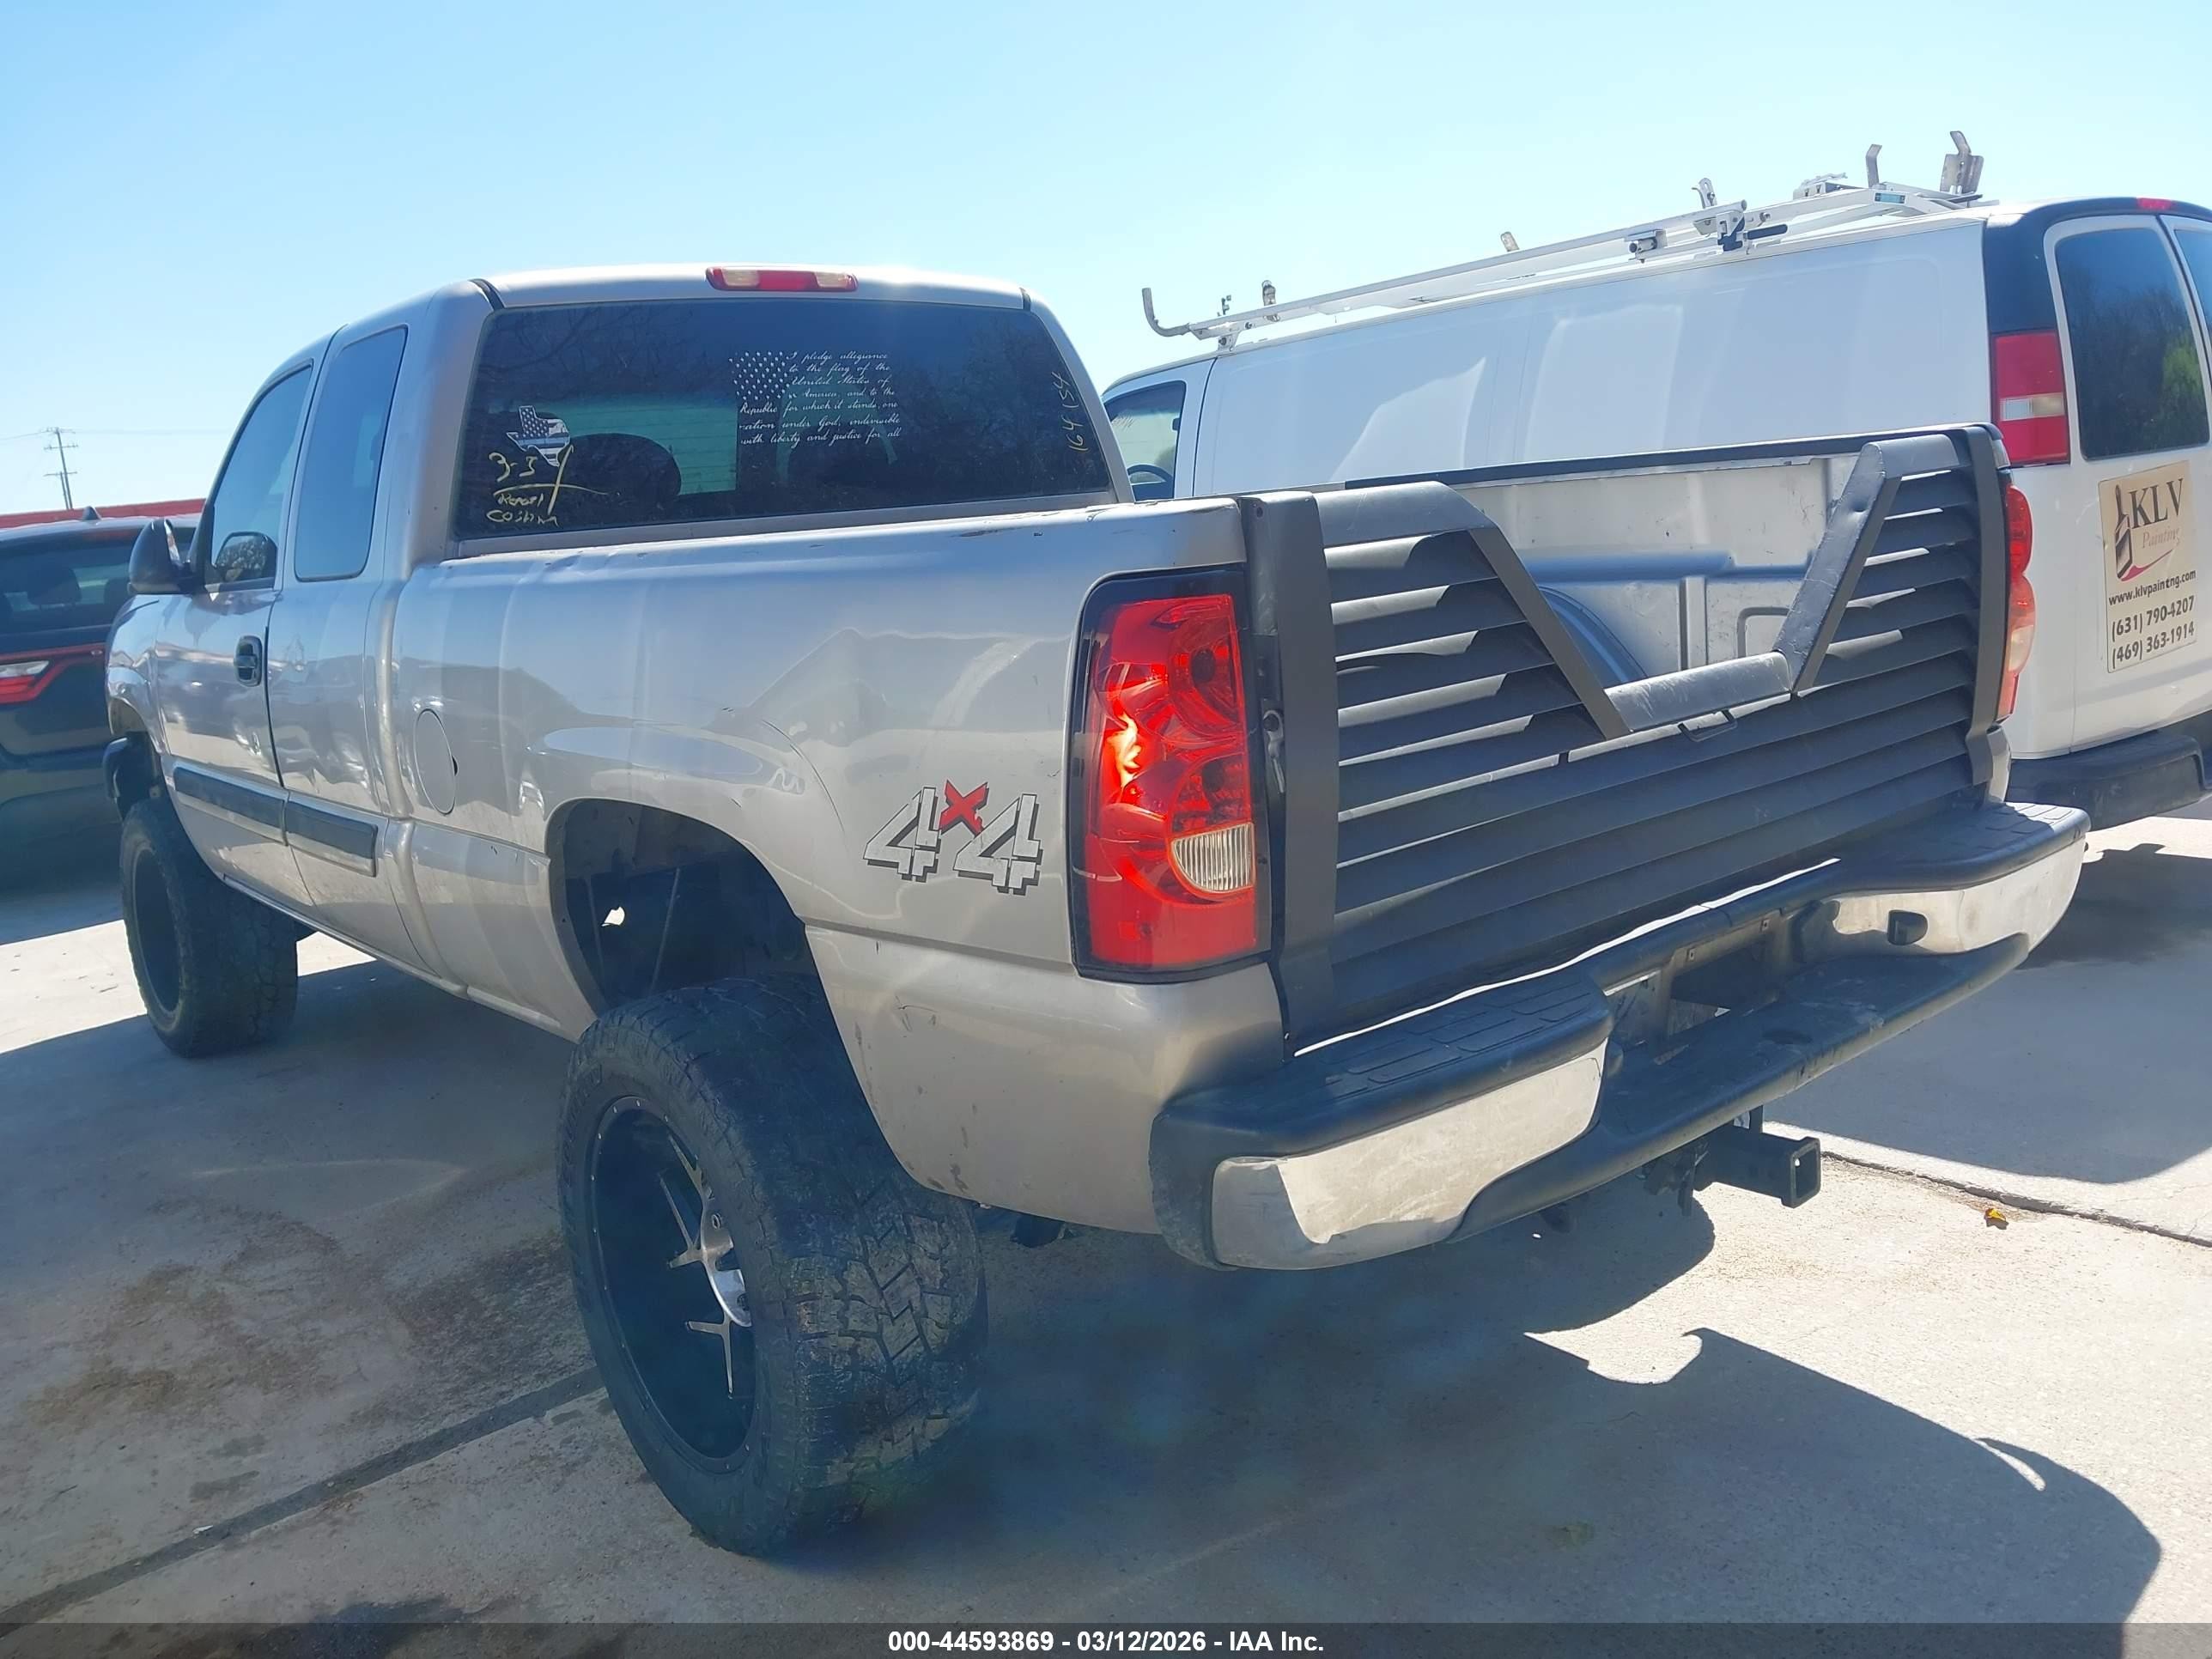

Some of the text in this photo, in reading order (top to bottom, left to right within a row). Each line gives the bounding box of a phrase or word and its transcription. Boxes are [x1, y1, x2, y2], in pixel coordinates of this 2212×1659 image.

[800, 350, 832, 366] pledge
[840, 350, 888, 365] allegiance
[789, 362, 890, 377] to the flag of the
[792, 374, 893, 388] United States of
[847, 387, 866, 397] and
[869, 386, 878, 396] to
[883, 386, 895, 396] the
[739, 401, 778, 416] Republic
[782, 400, 799, 418] for
[802, 399, 831, 410] which
[834, 398, 844, 410] it
[848, 398, 880, 410] stands,
[782, 416, 811, 428] under
[849, 412, 901, 426] indivisible
[740, 427, 902, 448] with liberty and justice for all
[2128, 477, 2184, 530] KLV
[2112, 594, 2195, 643] (631) 790-4207
[2112, 620, 2195, 670] (469) 363-1914
